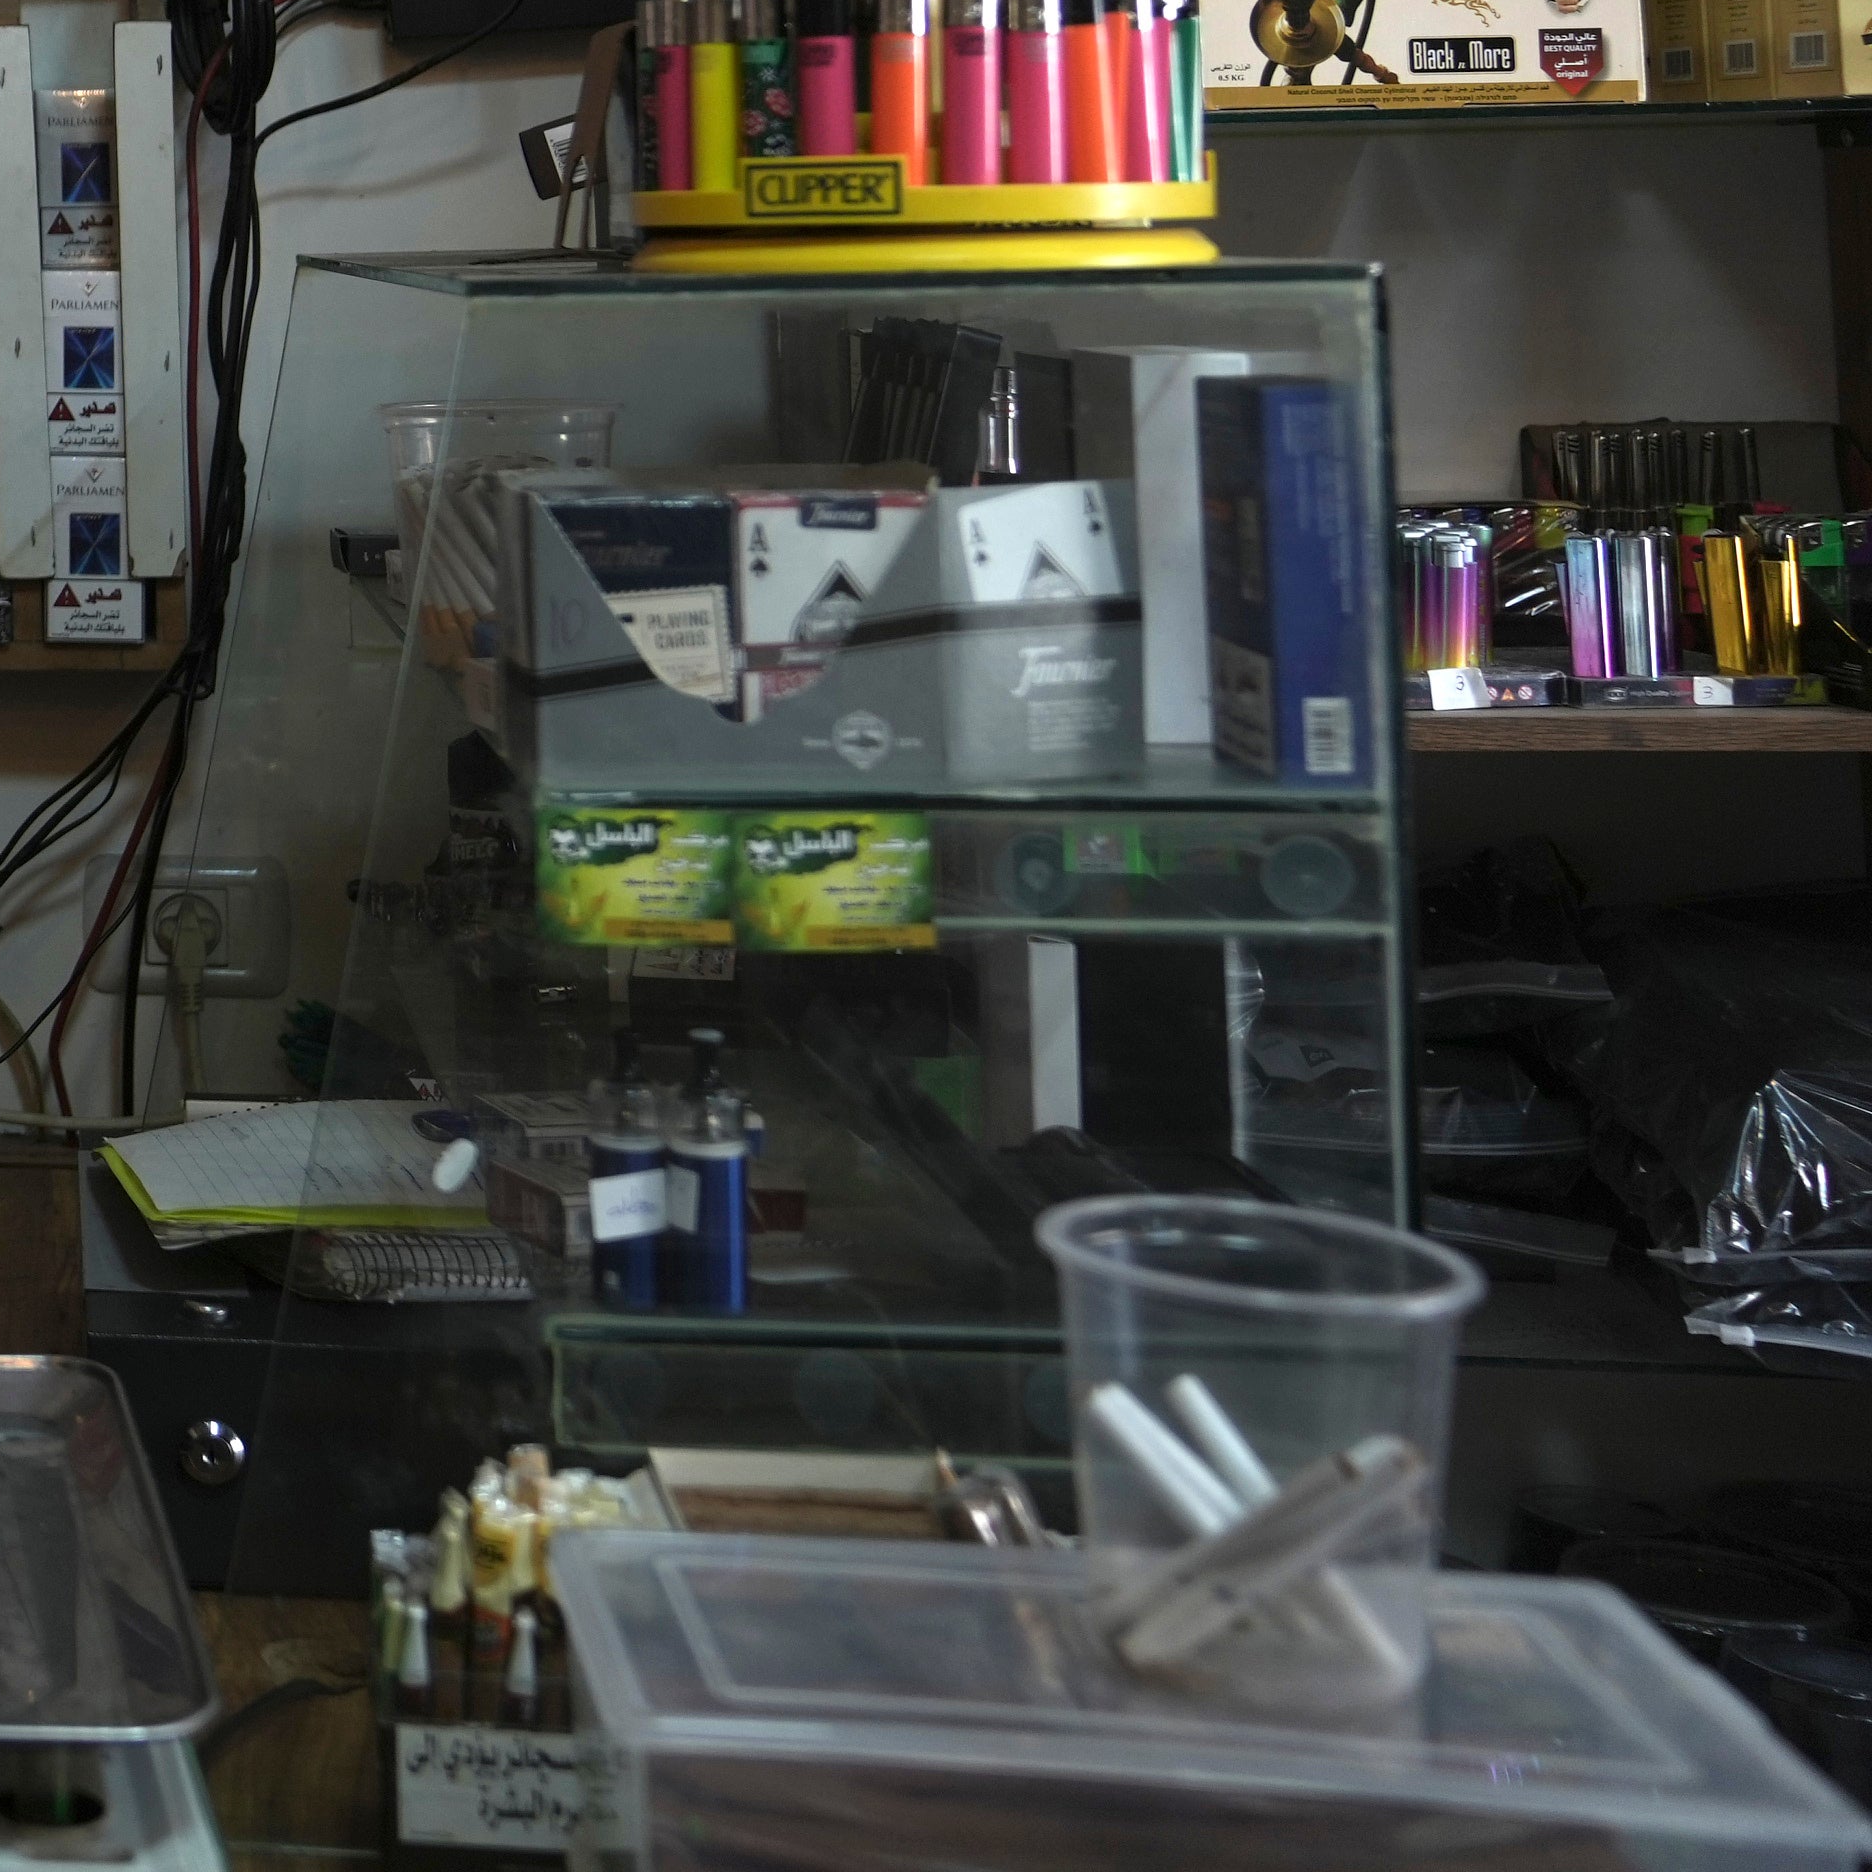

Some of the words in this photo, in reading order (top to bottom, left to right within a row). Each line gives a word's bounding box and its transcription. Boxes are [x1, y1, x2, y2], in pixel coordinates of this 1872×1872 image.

[1413, 41, 1454, 71] Black
[1469, 40, 1511, 69] More
[756, 169, 889, 207] CLIPPER
